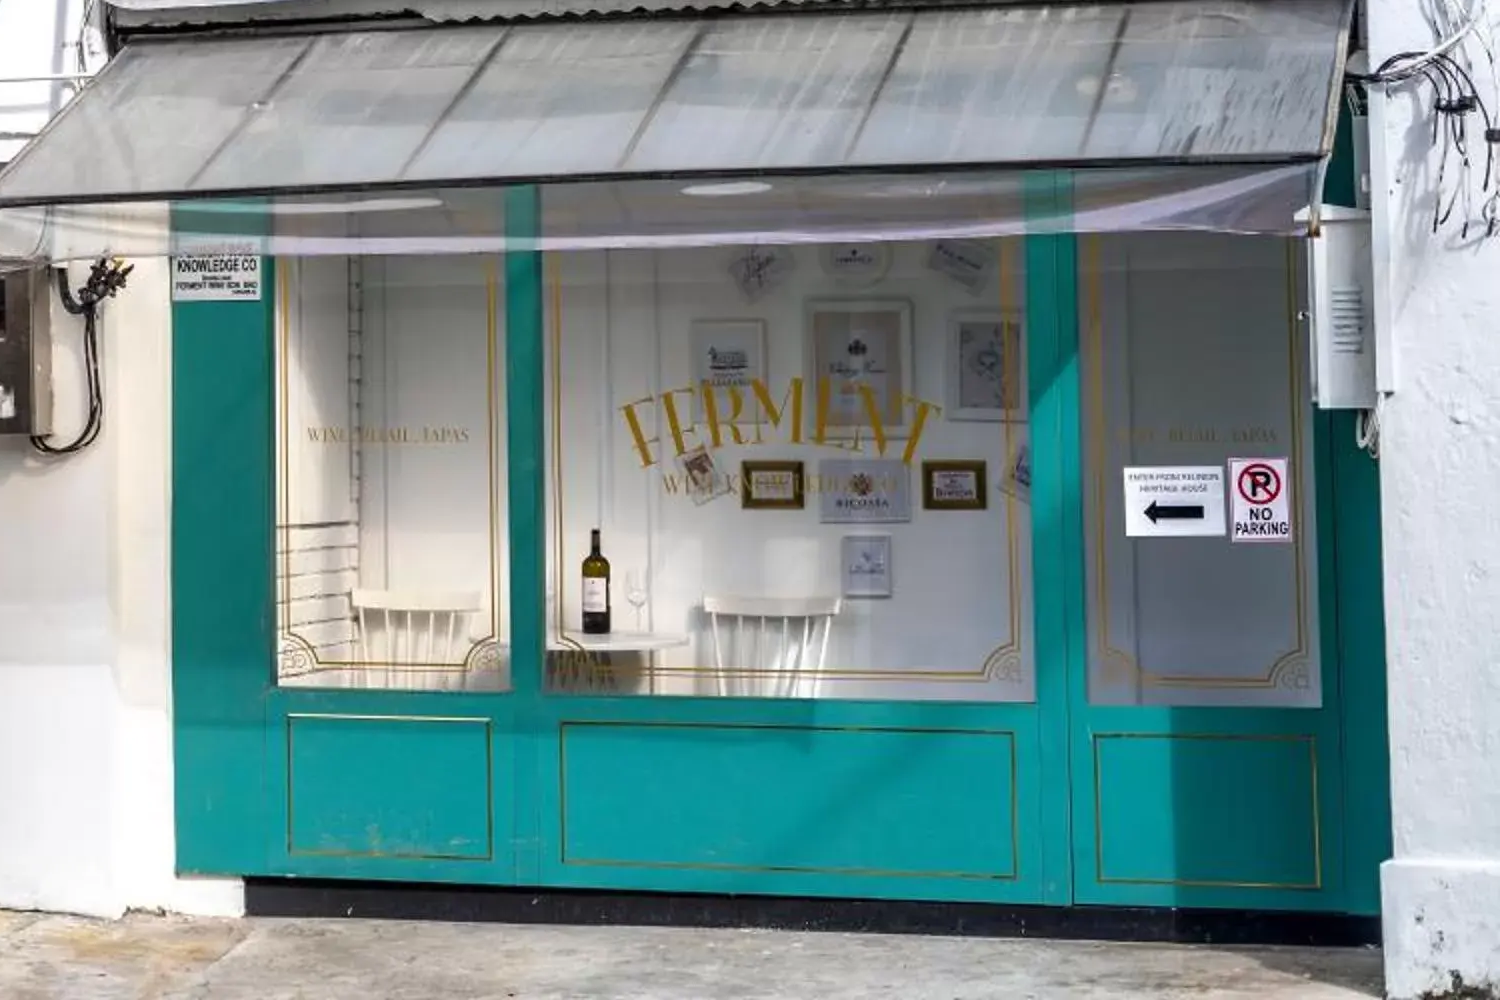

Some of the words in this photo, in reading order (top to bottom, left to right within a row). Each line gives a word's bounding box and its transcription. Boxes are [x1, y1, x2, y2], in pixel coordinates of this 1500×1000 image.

[178, 259, 240, 272] KNOWLEDGE
[242, 258, 257, 271] CO
[618, 377, 942, 468] FERMENT
[1249, 508, 1273, 521] NO
[1235, 522, 1289, 535] PARKING
